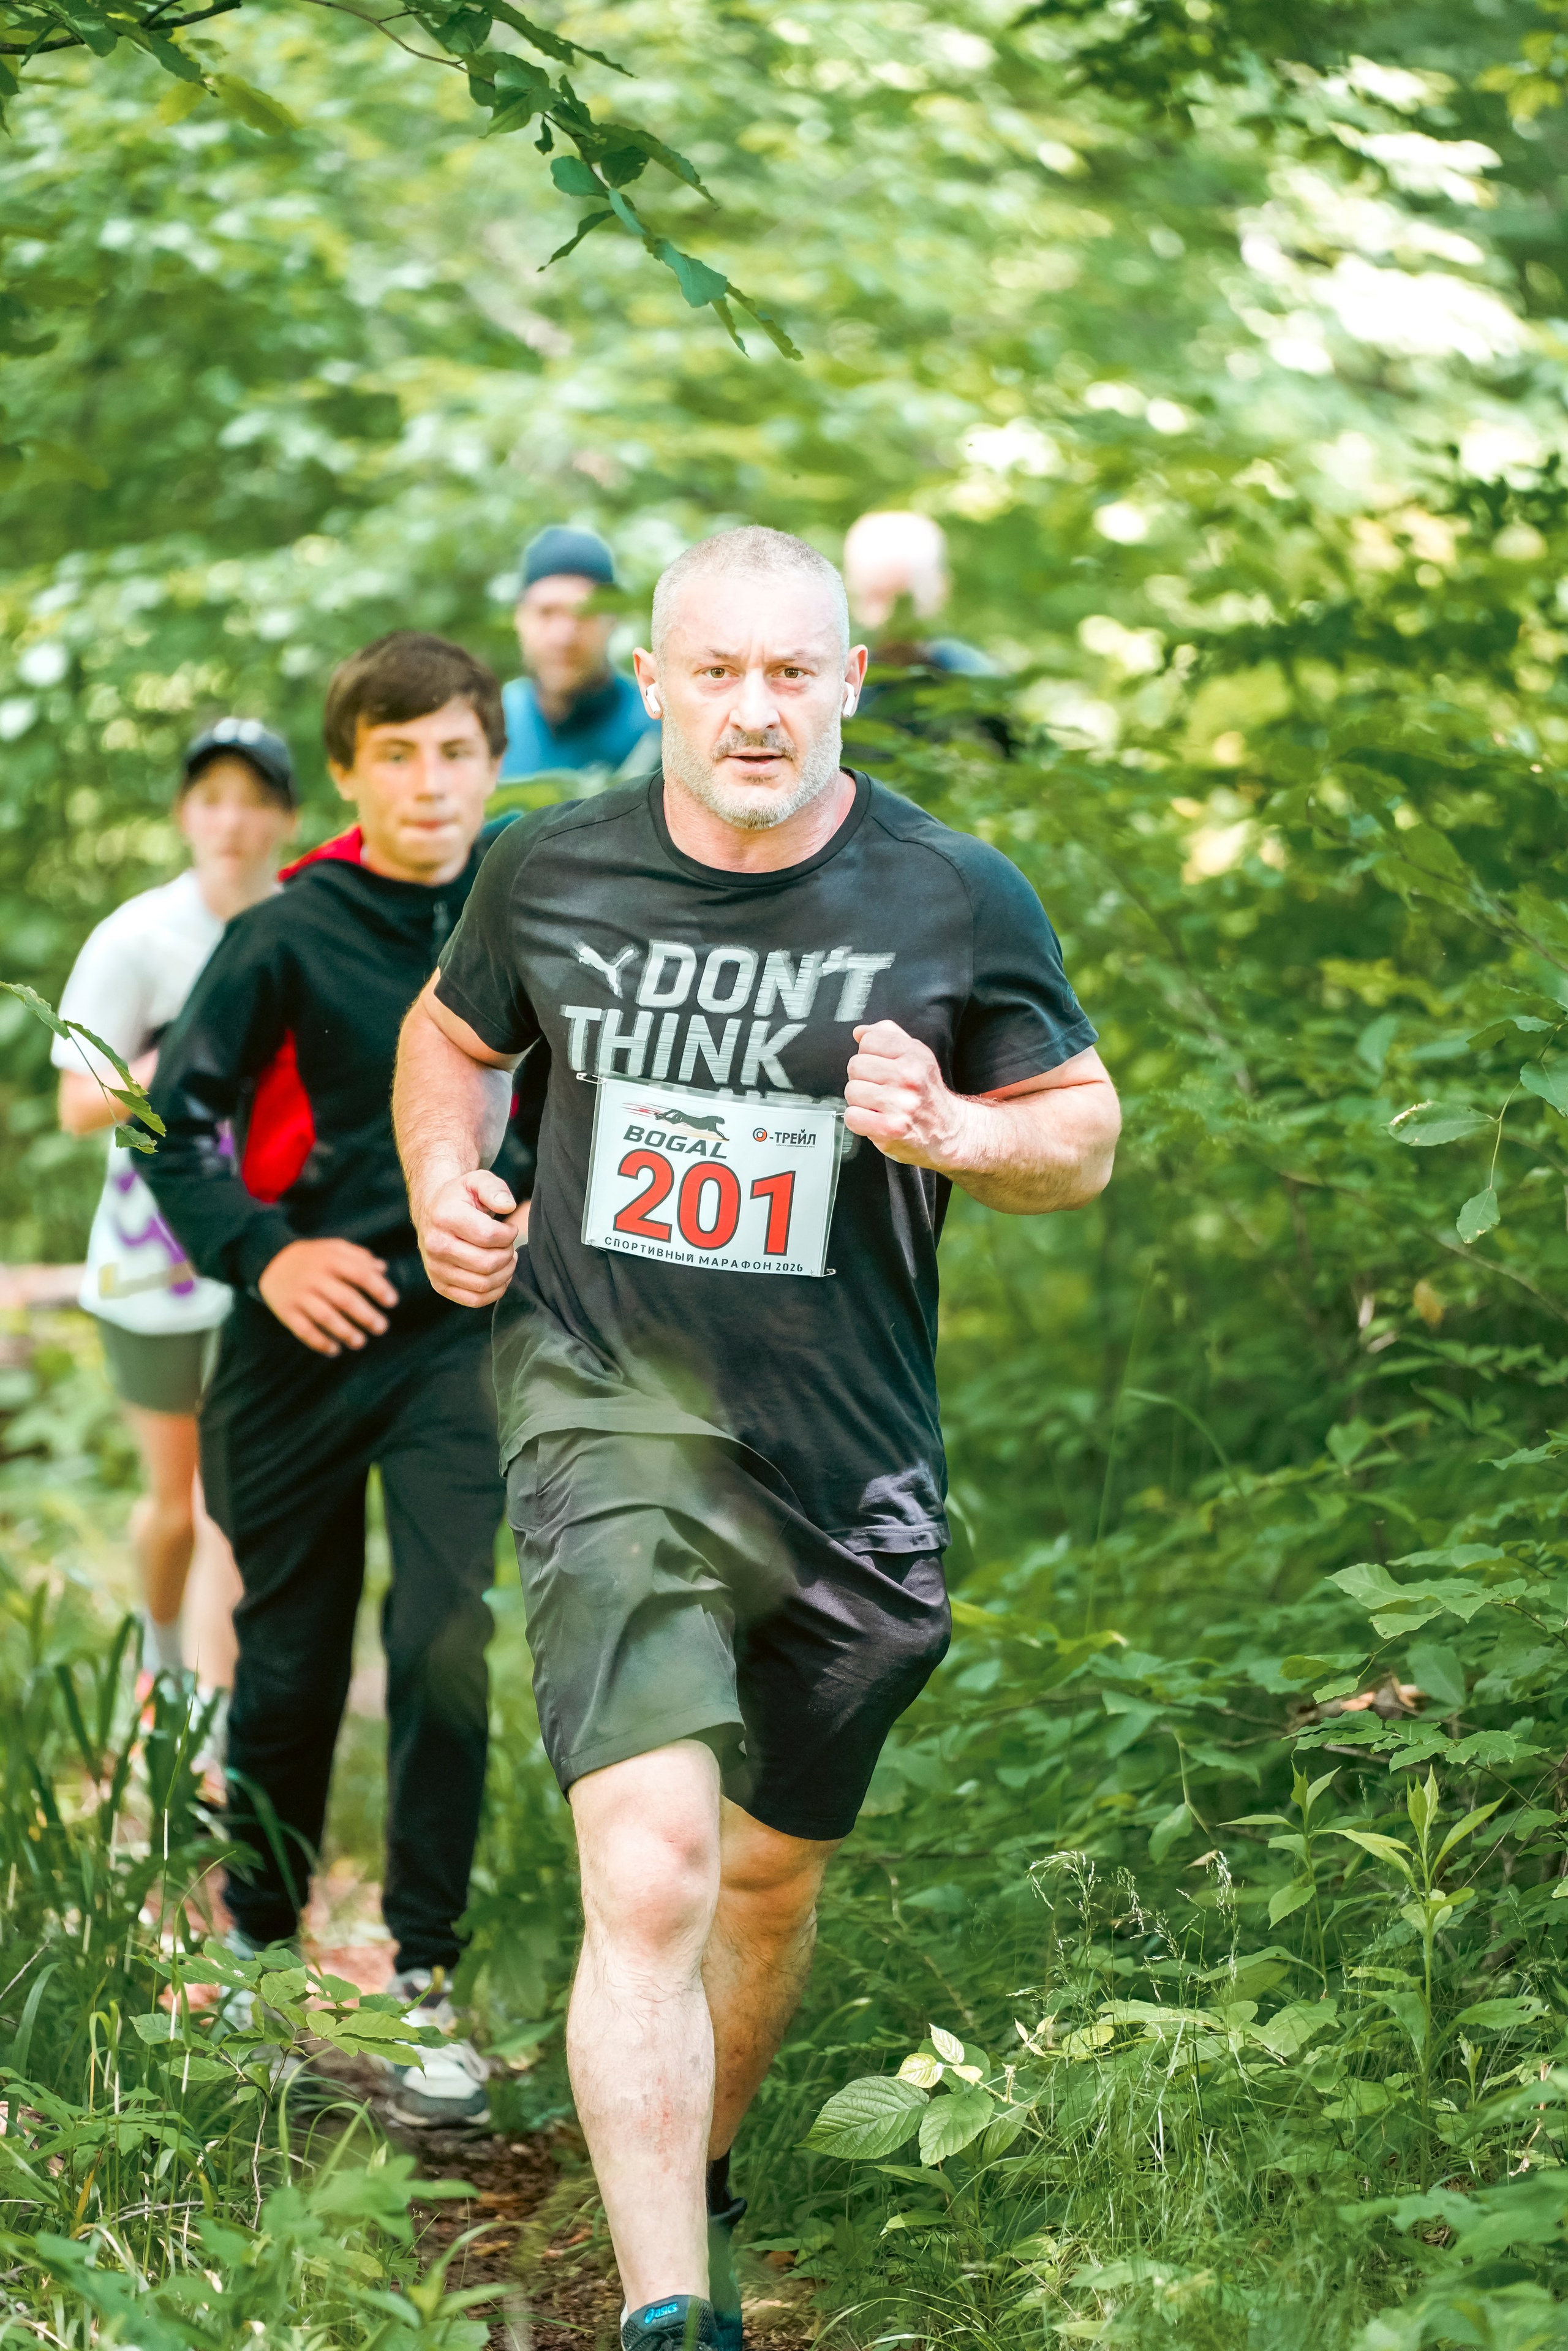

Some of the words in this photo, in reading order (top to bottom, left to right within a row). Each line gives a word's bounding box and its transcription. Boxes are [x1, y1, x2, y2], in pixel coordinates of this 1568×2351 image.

[636, 940, 895, 1022] DON'T
[561, 1005, 807, 1090] THINK
[623, 1125, 728, 1160] BOGAL
[612, 1149, 796, 1256] 201
[605, 1237, 694, 1263] СПОРТИВНЫЙ
[699, 1256, 771, 1270] МАРАФОН
[775, 1262, 803, 1272] 2026
